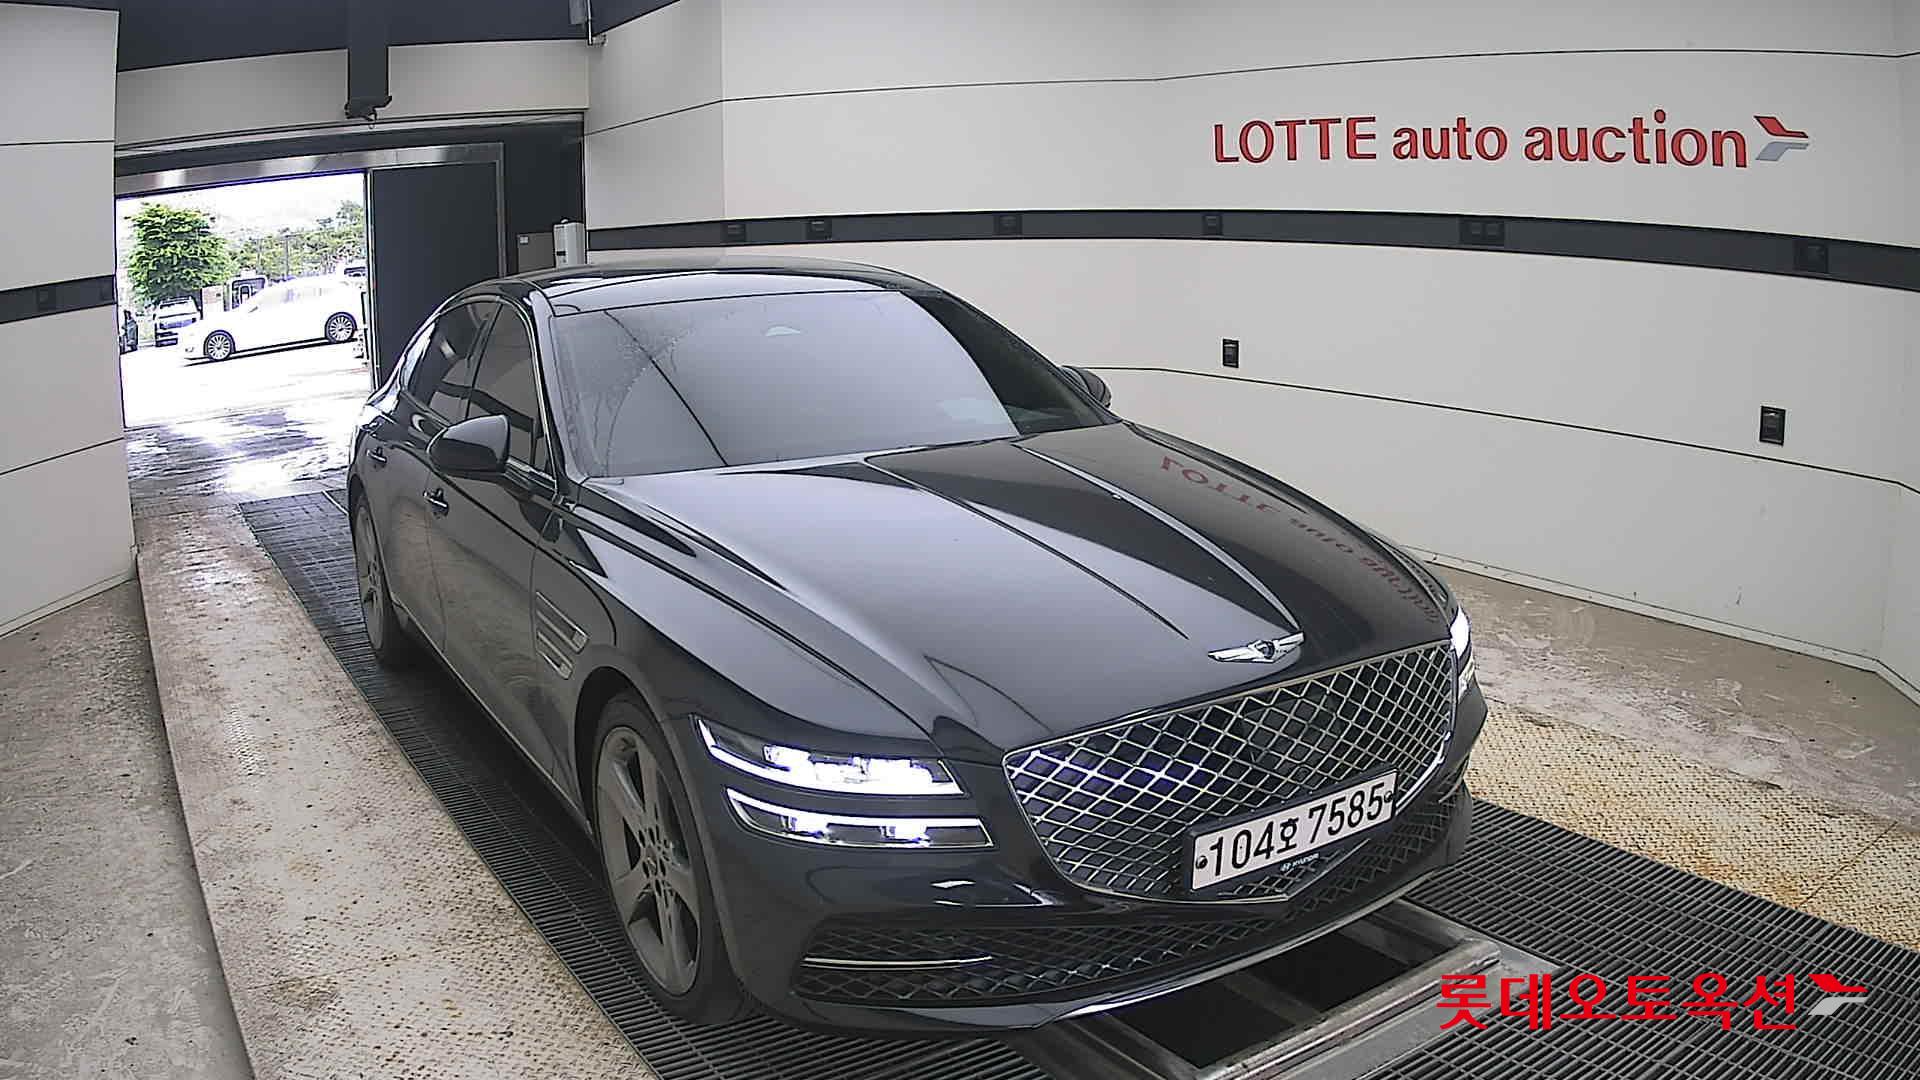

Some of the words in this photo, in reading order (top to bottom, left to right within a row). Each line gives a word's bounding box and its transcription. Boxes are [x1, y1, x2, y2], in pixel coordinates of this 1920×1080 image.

[1214, 115, 1377, 163] LOTTE
[1392, 116, 1509, 162] auto
[1523, 109, 1748, 168] auction
[1210, 817, 1300, 877] 104호
[1308, 782, 1385, 845] 7585
